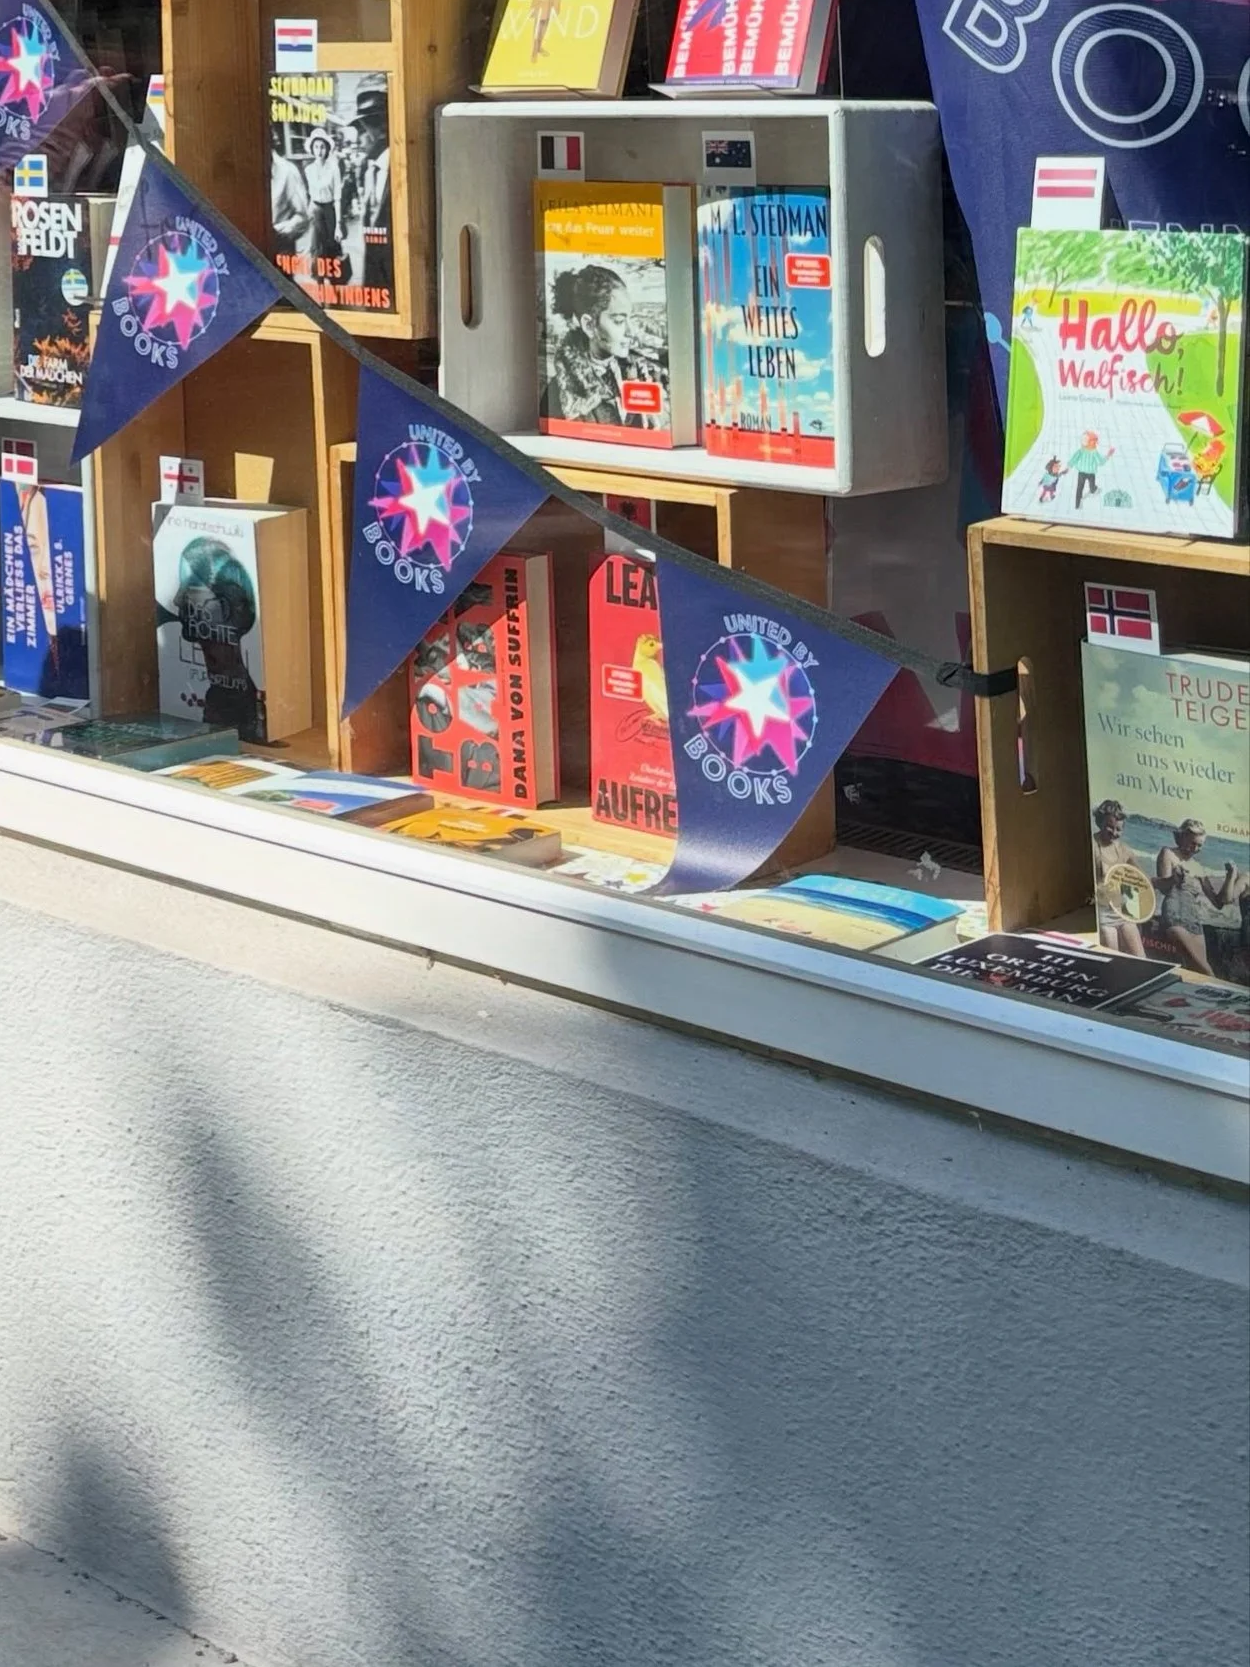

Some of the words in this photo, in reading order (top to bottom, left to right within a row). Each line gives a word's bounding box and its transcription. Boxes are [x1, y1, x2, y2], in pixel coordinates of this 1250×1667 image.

[11, 201, 83, 232] ROSEN
[710, 205, 729, 235] M.
[732, 204, 746, 235] L.
[750, 203, 828, 239] STEDMAN
[20, 230, 78, 259] FELDT
[316, 258, 342, 279] DES
[754, 265, 781, 298] EIN
[111, 296, 179, 369] BOOKS
[741, 304, 798, 340] WEITES
[1058, 298, 1185, 361] Hallo,
[747, 344, 797, 380] LEBEN
[1058, 354, 1184, 398] Walfisch!
[740, 412, 772, 432] ROMAN
[408, 424, 464, 460] UNITED
[461, 458, 482, 483] BY
[12, 525, 23, 555] DAS
[362, 521, 445, 594] BOOKS
[3, 531, 16, 613] MÄDCHEN
[54, 554, 66, 615] ULRIKKA
[63, 551, 75, 606] GERNES
[606, 560, 658, 611] LEA
[13, 559, 26, 632] VERLIESS
[26, 584, 37, 649] ZIMMER
[504, 567, 522, 667] SUFFRIN
[5, 616, 16, 644] EIN
[723, 613, 792, 646] UNITED
[792, 641, 820, 669] BY
[509, 675, 524, 721] VON
[1166, 672, 1250, 706] TRUDE
[1098, 712, 1130, 737] Wir
[1135, 724, 1184, 749] sehen
[1171, 695, 1249, 731] TEIGE
[511, 730, 528, 799] DANA
[683, 733, 792, 805] BOOKS
[1136, 751, 1169, 770] uns
[1173, 757, 1235, 785] wieder
[596, 778, 678, 833] AUFRE
[1117, 773, 1142, 789] am
[1148, 774, 1193, 801] Meer
[937, 954, 1109, 998] LUXEMBURG
[986, 952, 1062, 975] ORTE
[1061, 969, 1099, 983] IN
